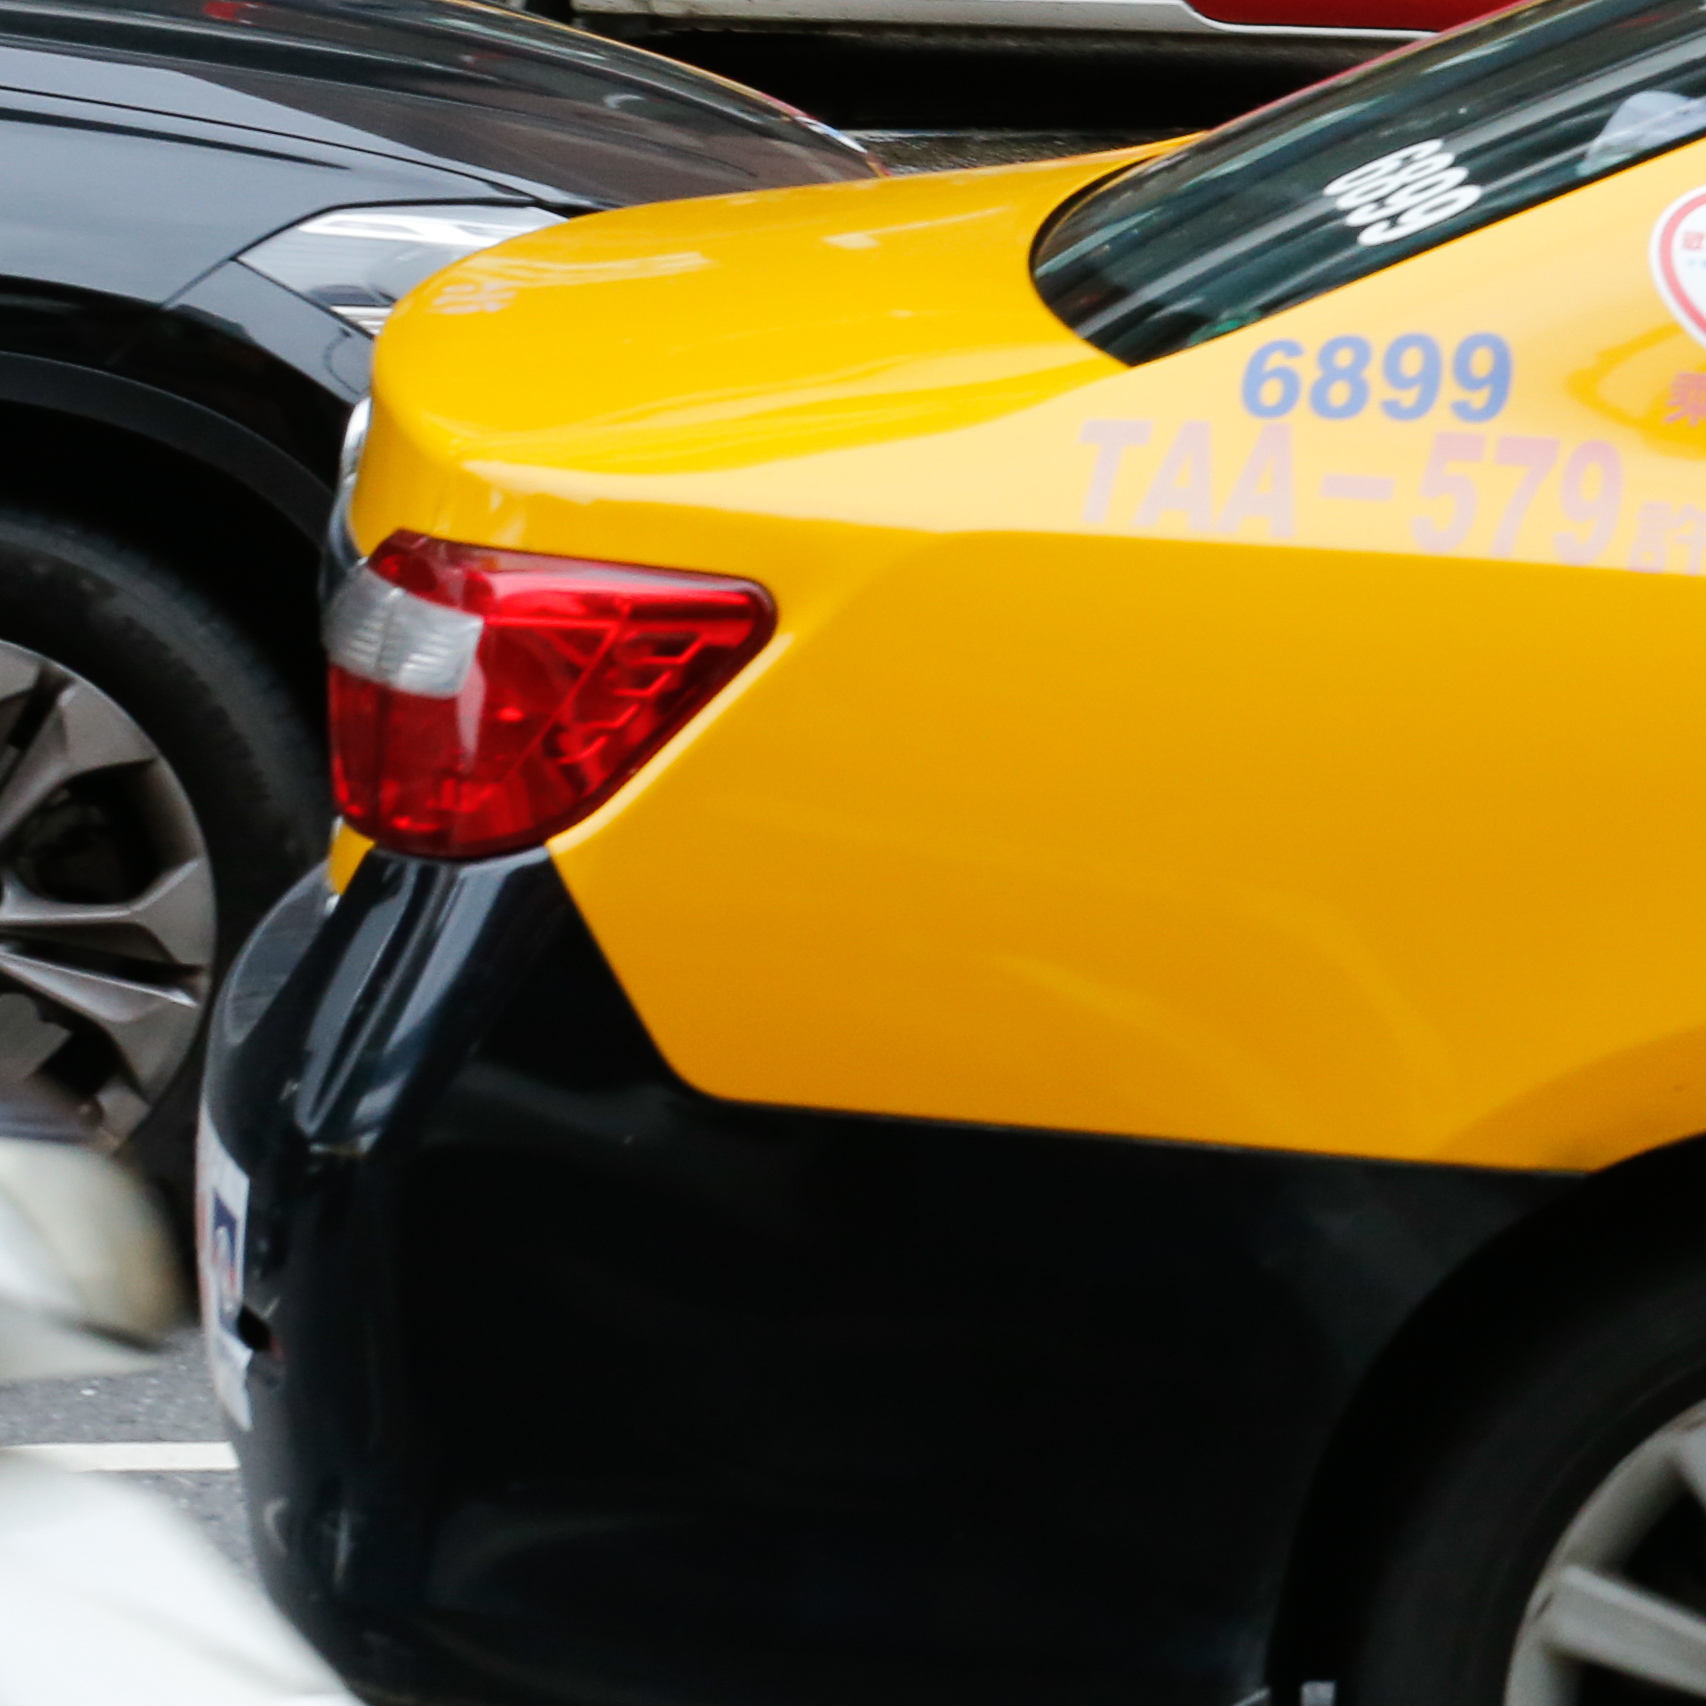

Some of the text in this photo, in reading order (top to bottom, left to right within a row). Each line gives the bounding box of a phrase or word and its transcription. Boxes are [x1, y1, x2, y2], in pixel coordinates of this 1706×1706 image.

[1322, 139, 1483, 247] 6899
[1241, 333, 1512, 422] 6899
[1078, 419, 1624, 566] TAA-579
